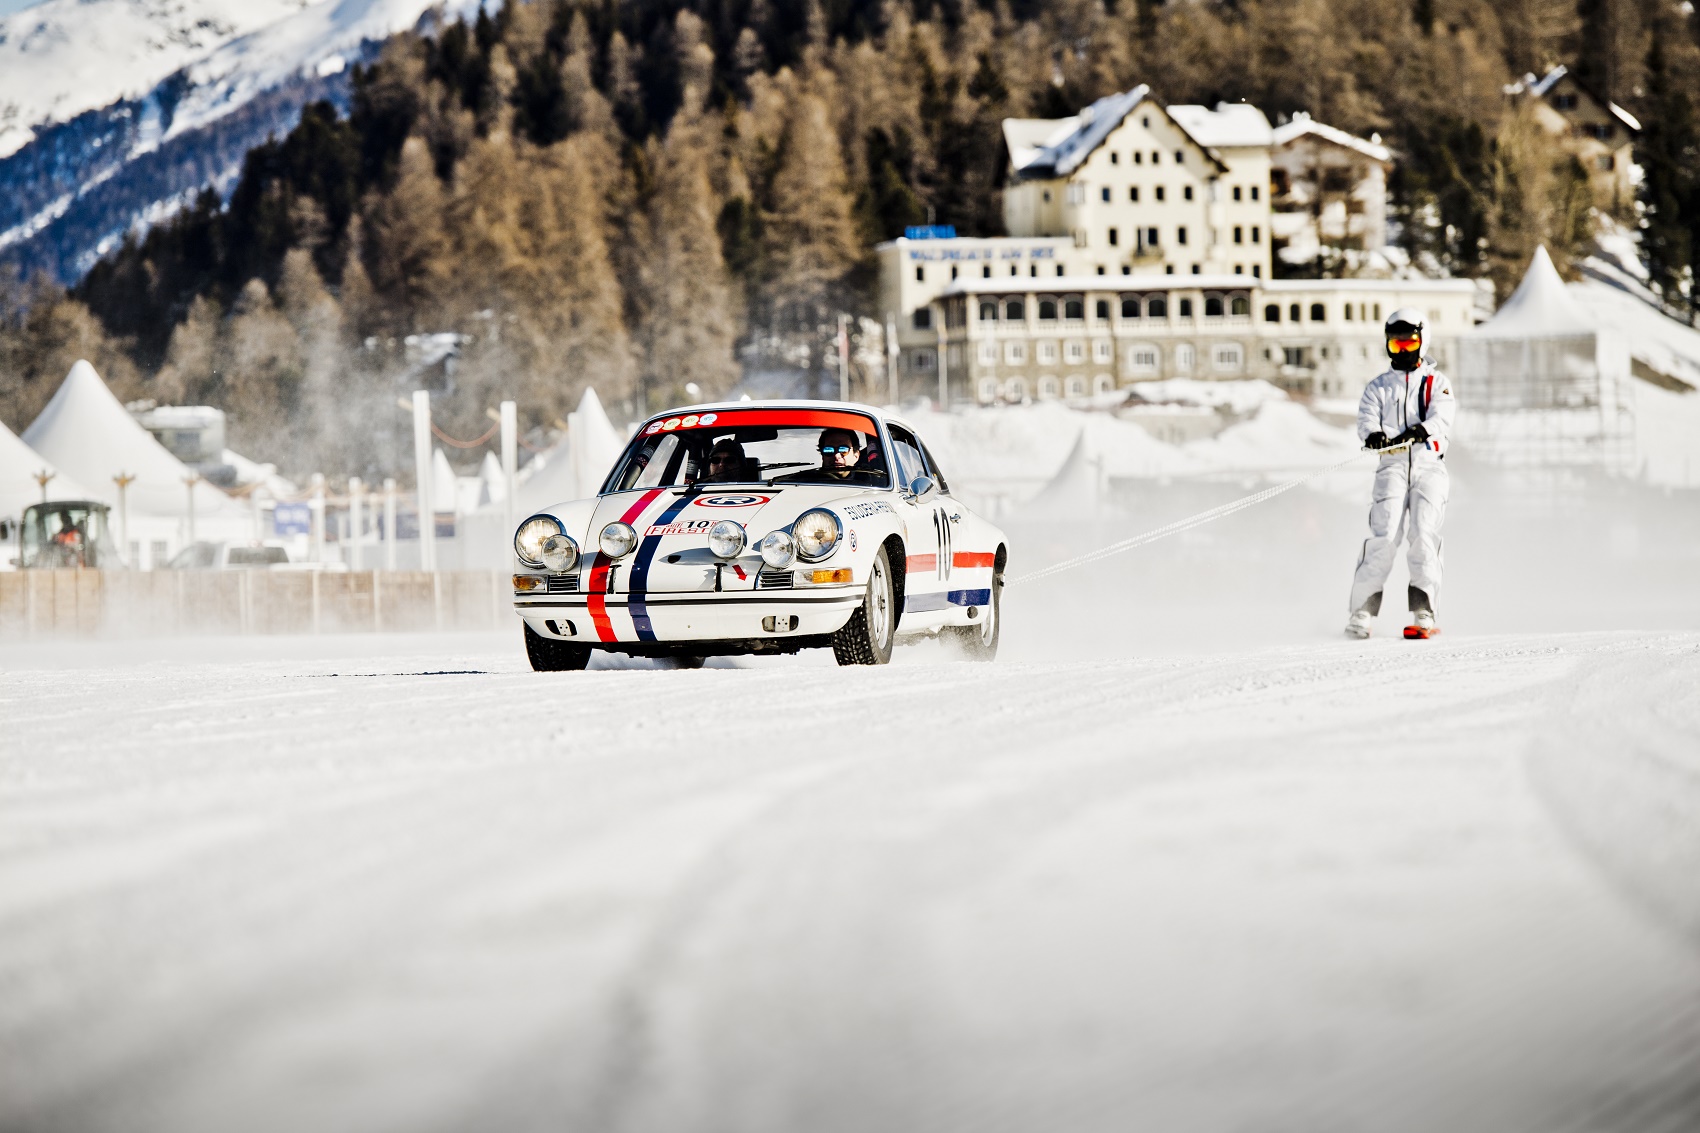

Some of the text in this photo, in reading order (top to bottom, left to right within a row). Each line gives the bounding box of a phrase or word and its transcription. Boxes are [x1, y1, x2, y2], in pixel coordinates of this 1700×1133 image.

[687, 520, 710, 528] 10
[650, 526, 711, 535] FIREST
[933, 507, 951, 581] 10
